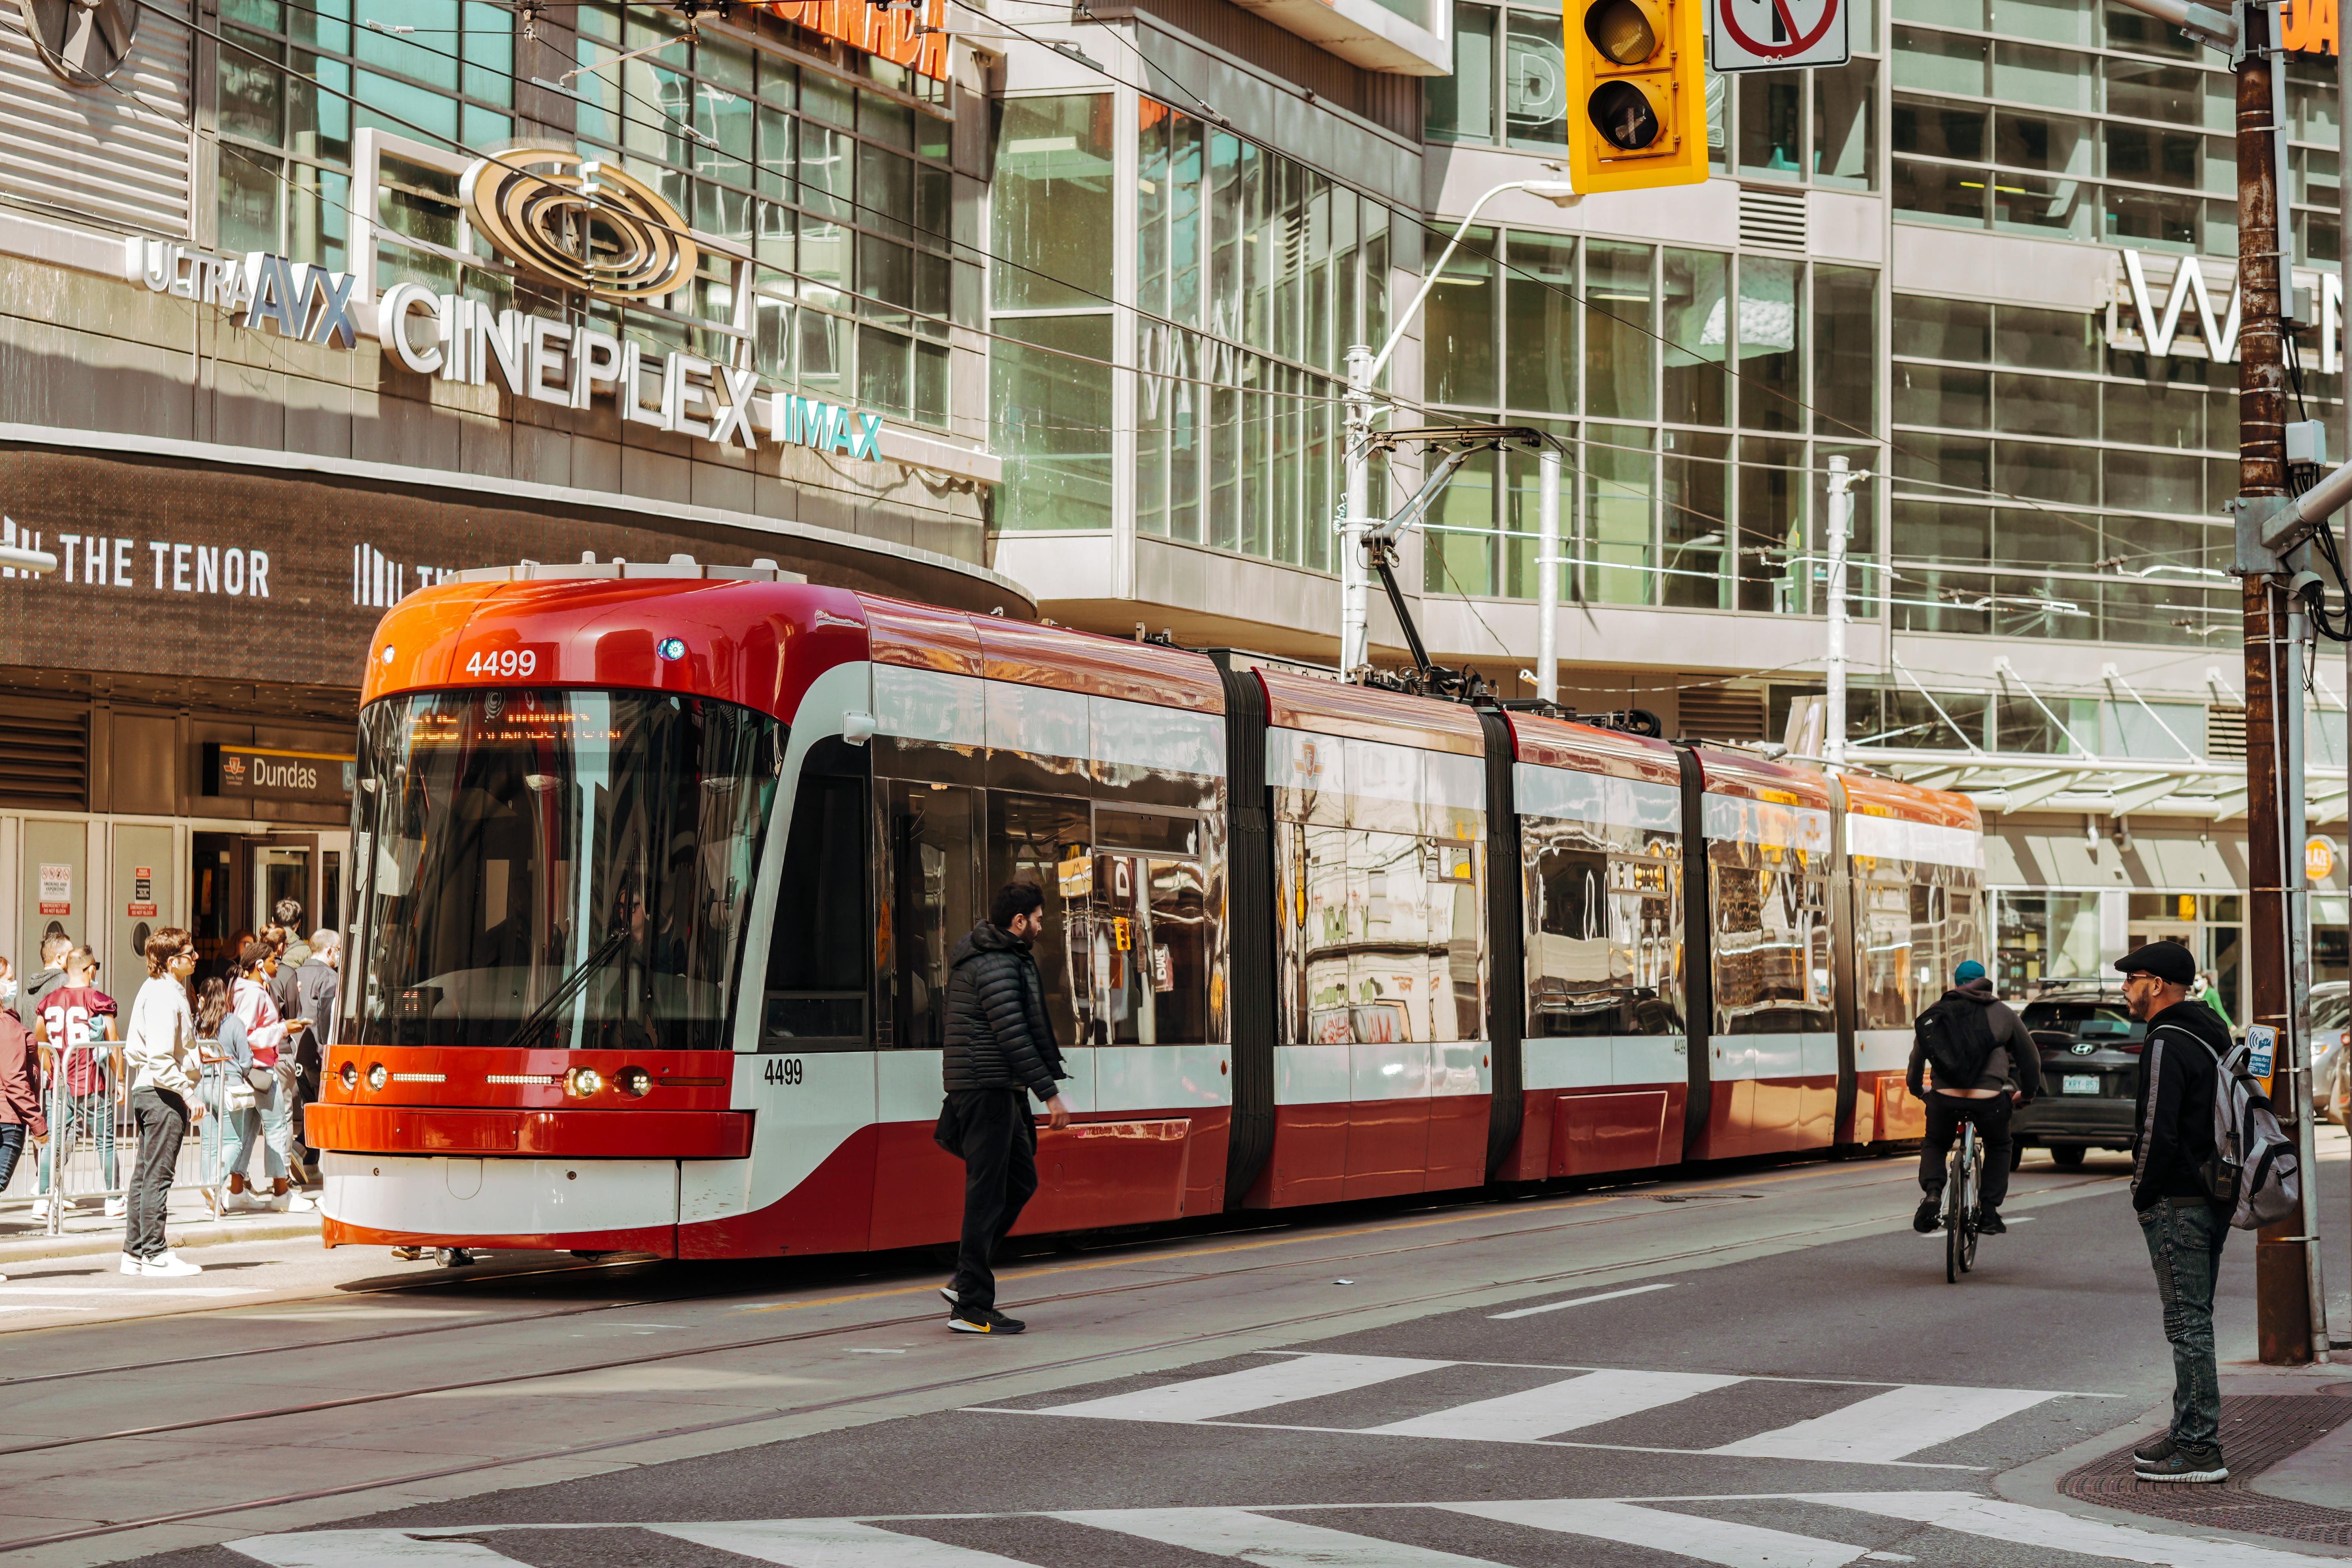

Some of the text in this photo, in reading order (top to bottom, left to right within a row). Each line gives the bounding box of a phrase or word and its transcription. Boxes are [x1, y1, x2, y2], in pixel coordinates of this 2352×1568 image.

[126, 236, 357, 350] ULTRA AVX
[379, 282, 883, 463] CINEPLEX IMAX
[60, 534, 270, 597] THE TENOR
[466, 649, 536, 677] 4499
[254, 758, 316, 789] Dundas
[2306, 848, 2328, 866] LAZE
[44, 1006, 90, 1049] 26
[1674, 1039, 1686, 1055] 4499
[764, 1059, 802, 1085] 4499
[2086, 1080, 2098, 1089] 857
